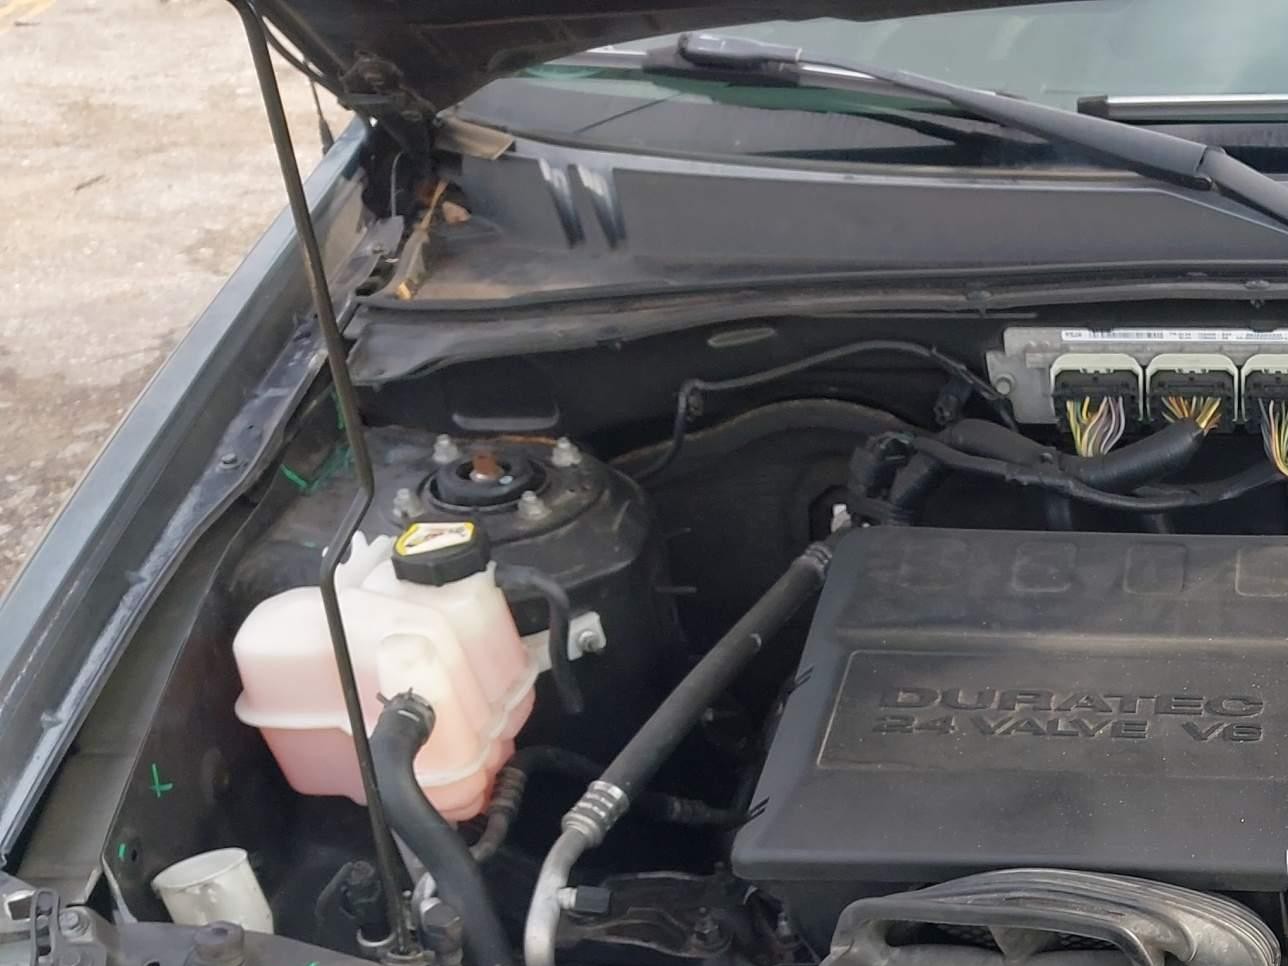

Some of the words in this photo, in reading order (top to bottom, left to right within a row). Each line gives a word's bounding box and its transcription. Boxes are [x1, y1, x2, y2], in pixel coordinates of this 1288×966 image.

[879, 687, 1264, 717] DURATEC
[872, 715, 957, 734] 24
[970, 715, 1151, 740] VALVE
[1181, 720, 1263, 743] V6
